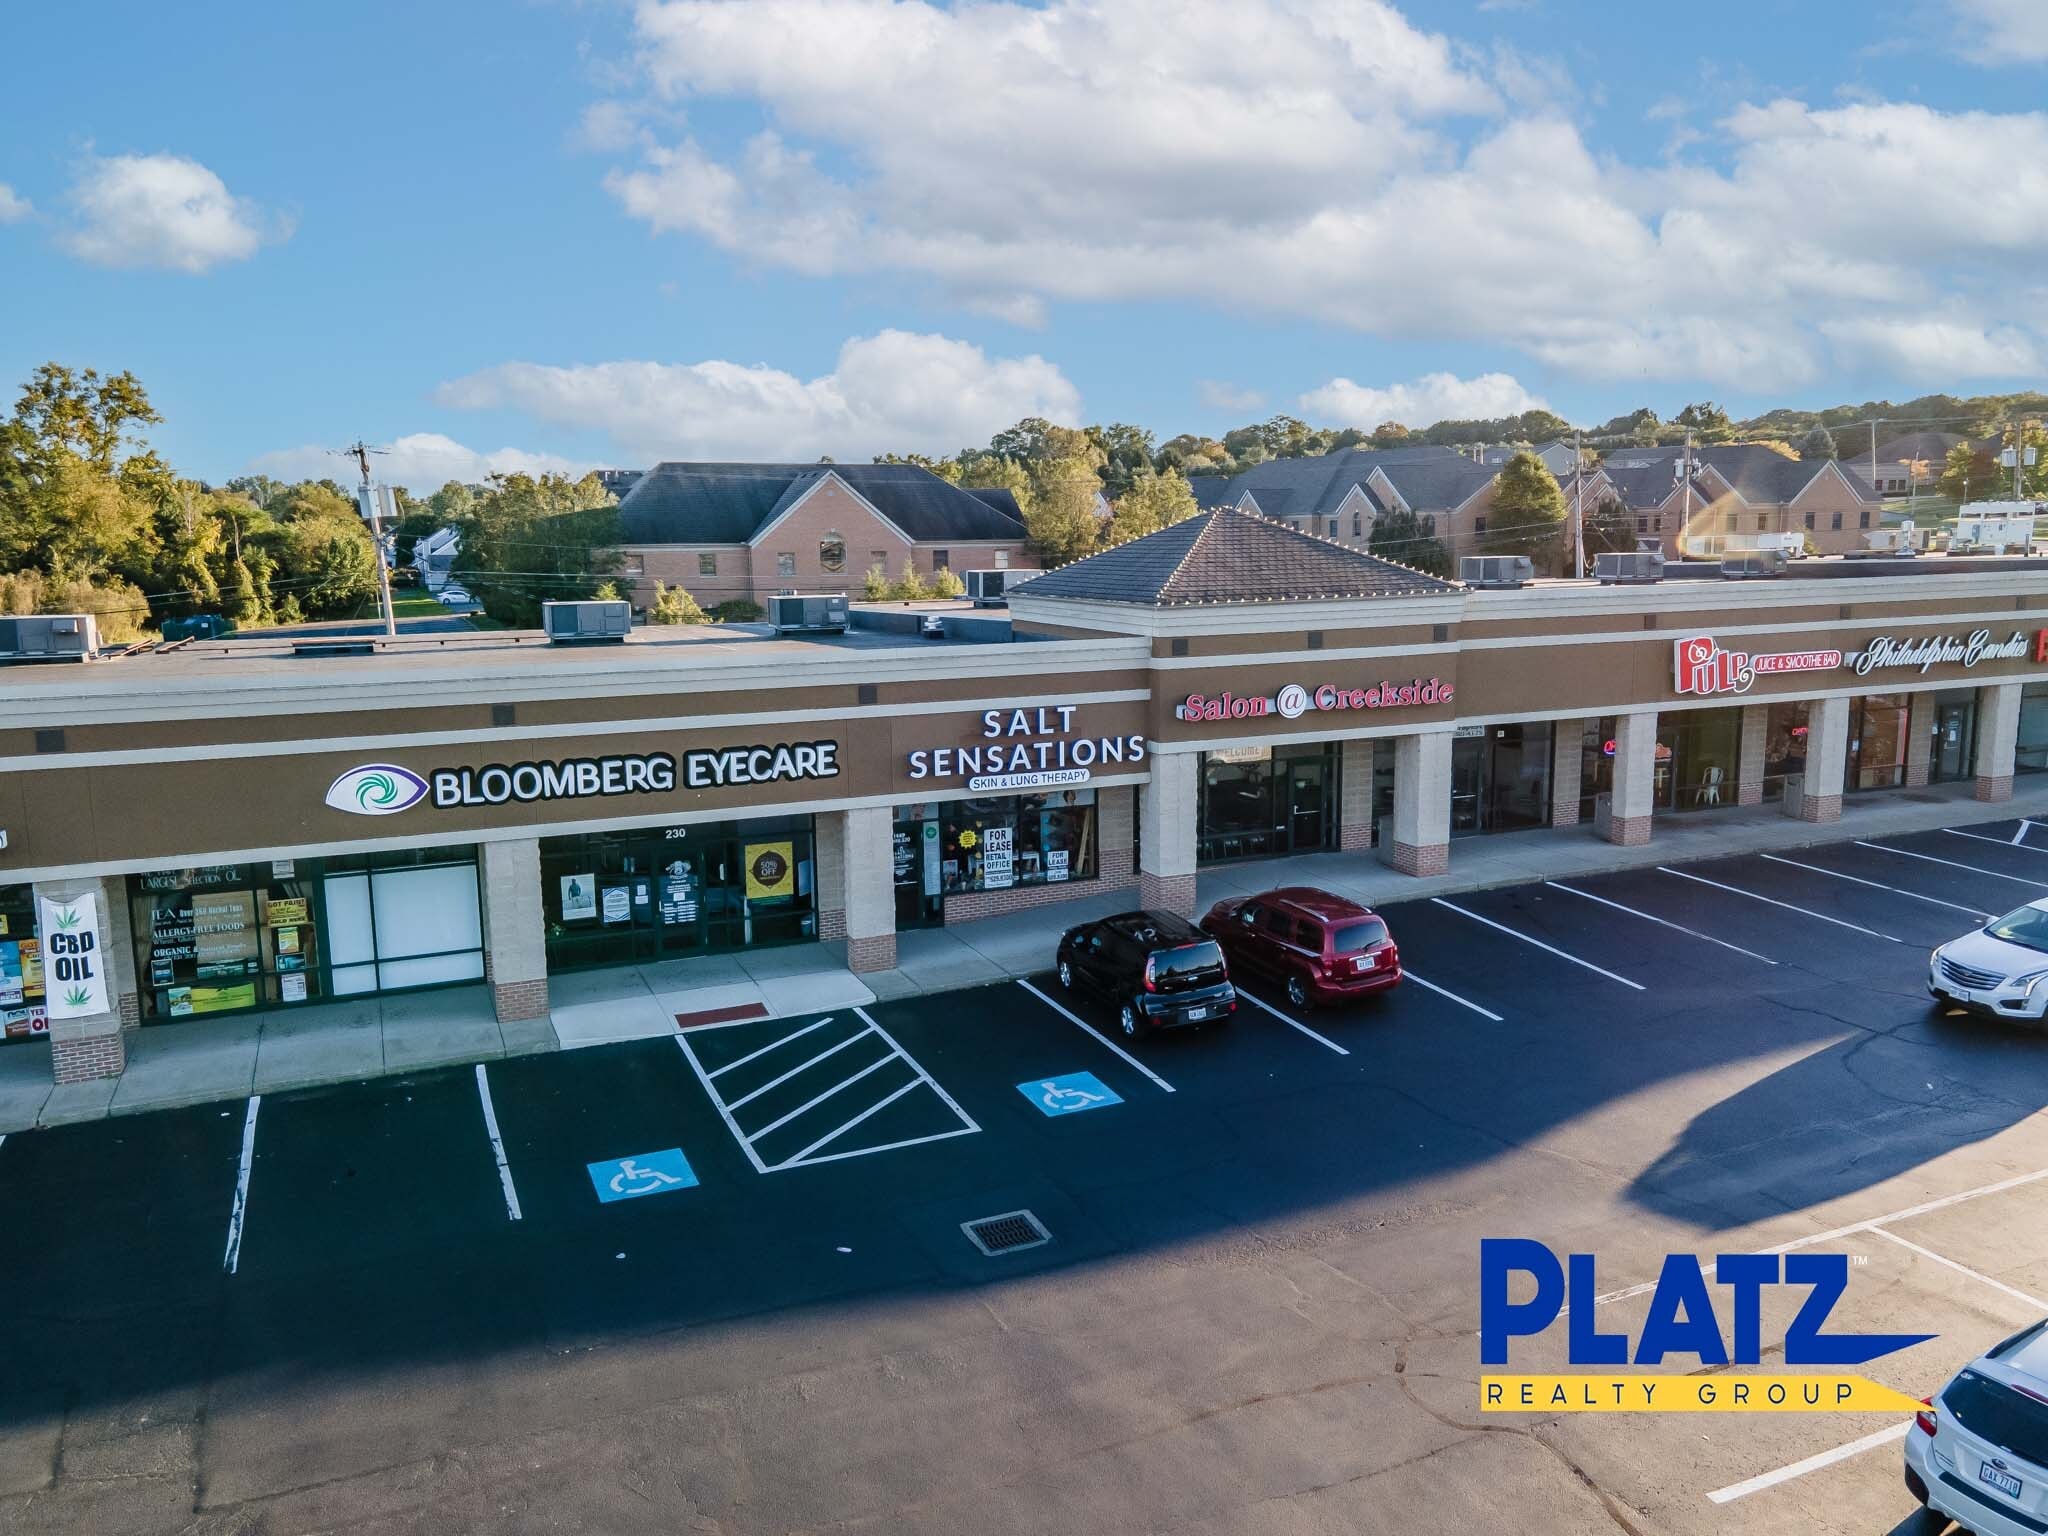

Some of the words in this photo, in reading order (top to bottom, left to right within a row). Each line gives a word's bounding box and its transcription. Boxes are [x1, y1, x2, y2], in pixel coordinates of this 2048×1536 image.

[1855, 635, 1966, 676] Philadelphia
[1965, 629, 2029, 668] Candies
[1678, 636, 1754, 694] PULP
[1757, 657, 1776, 671] JUICE
[1778, 658, 1784, 669] &
[1785, 655, 1822, 669] SMOOTHIE
[1823, 653, 1837, 666] BAR
[1185, 692, 1269, 721] Salon
[1281, 686, 1303, 716] @
[1315, 677, 1455, 711] Creekside
[983, 706, 1077, 737] SALT
[910, 735, 1144, 779] SENSATIONS
[435, 758, 674, 805] BLOOMBERG
[687, 745, 838, 787] EYECARE
[973, 776, 998, 788] SKIN
[1000, 777, 1007, 787] &
[1010, 774, 1038, 786] LUNG
[1041, 771, 1087, 784] THERAPY
[665, 828, 686, 839] 230
[989, 830, 1006, 840] FOR
[985, 841, 1011, 853] LEASE
[986, 853, 1007, 861] RETAIL
[760, 860, 778, 869] 50%
[986, 861, 1011, 869] OFFICE
[761, 868, 776, 876] OFF
[217, 922, 245, 932] FOODS
[50, 931, 94, 954] CBD
[153, 945, 191, 957] ORGANIC
[55, 956, 94, 981] OIL
[30, 1008, 45, 1016] YES
